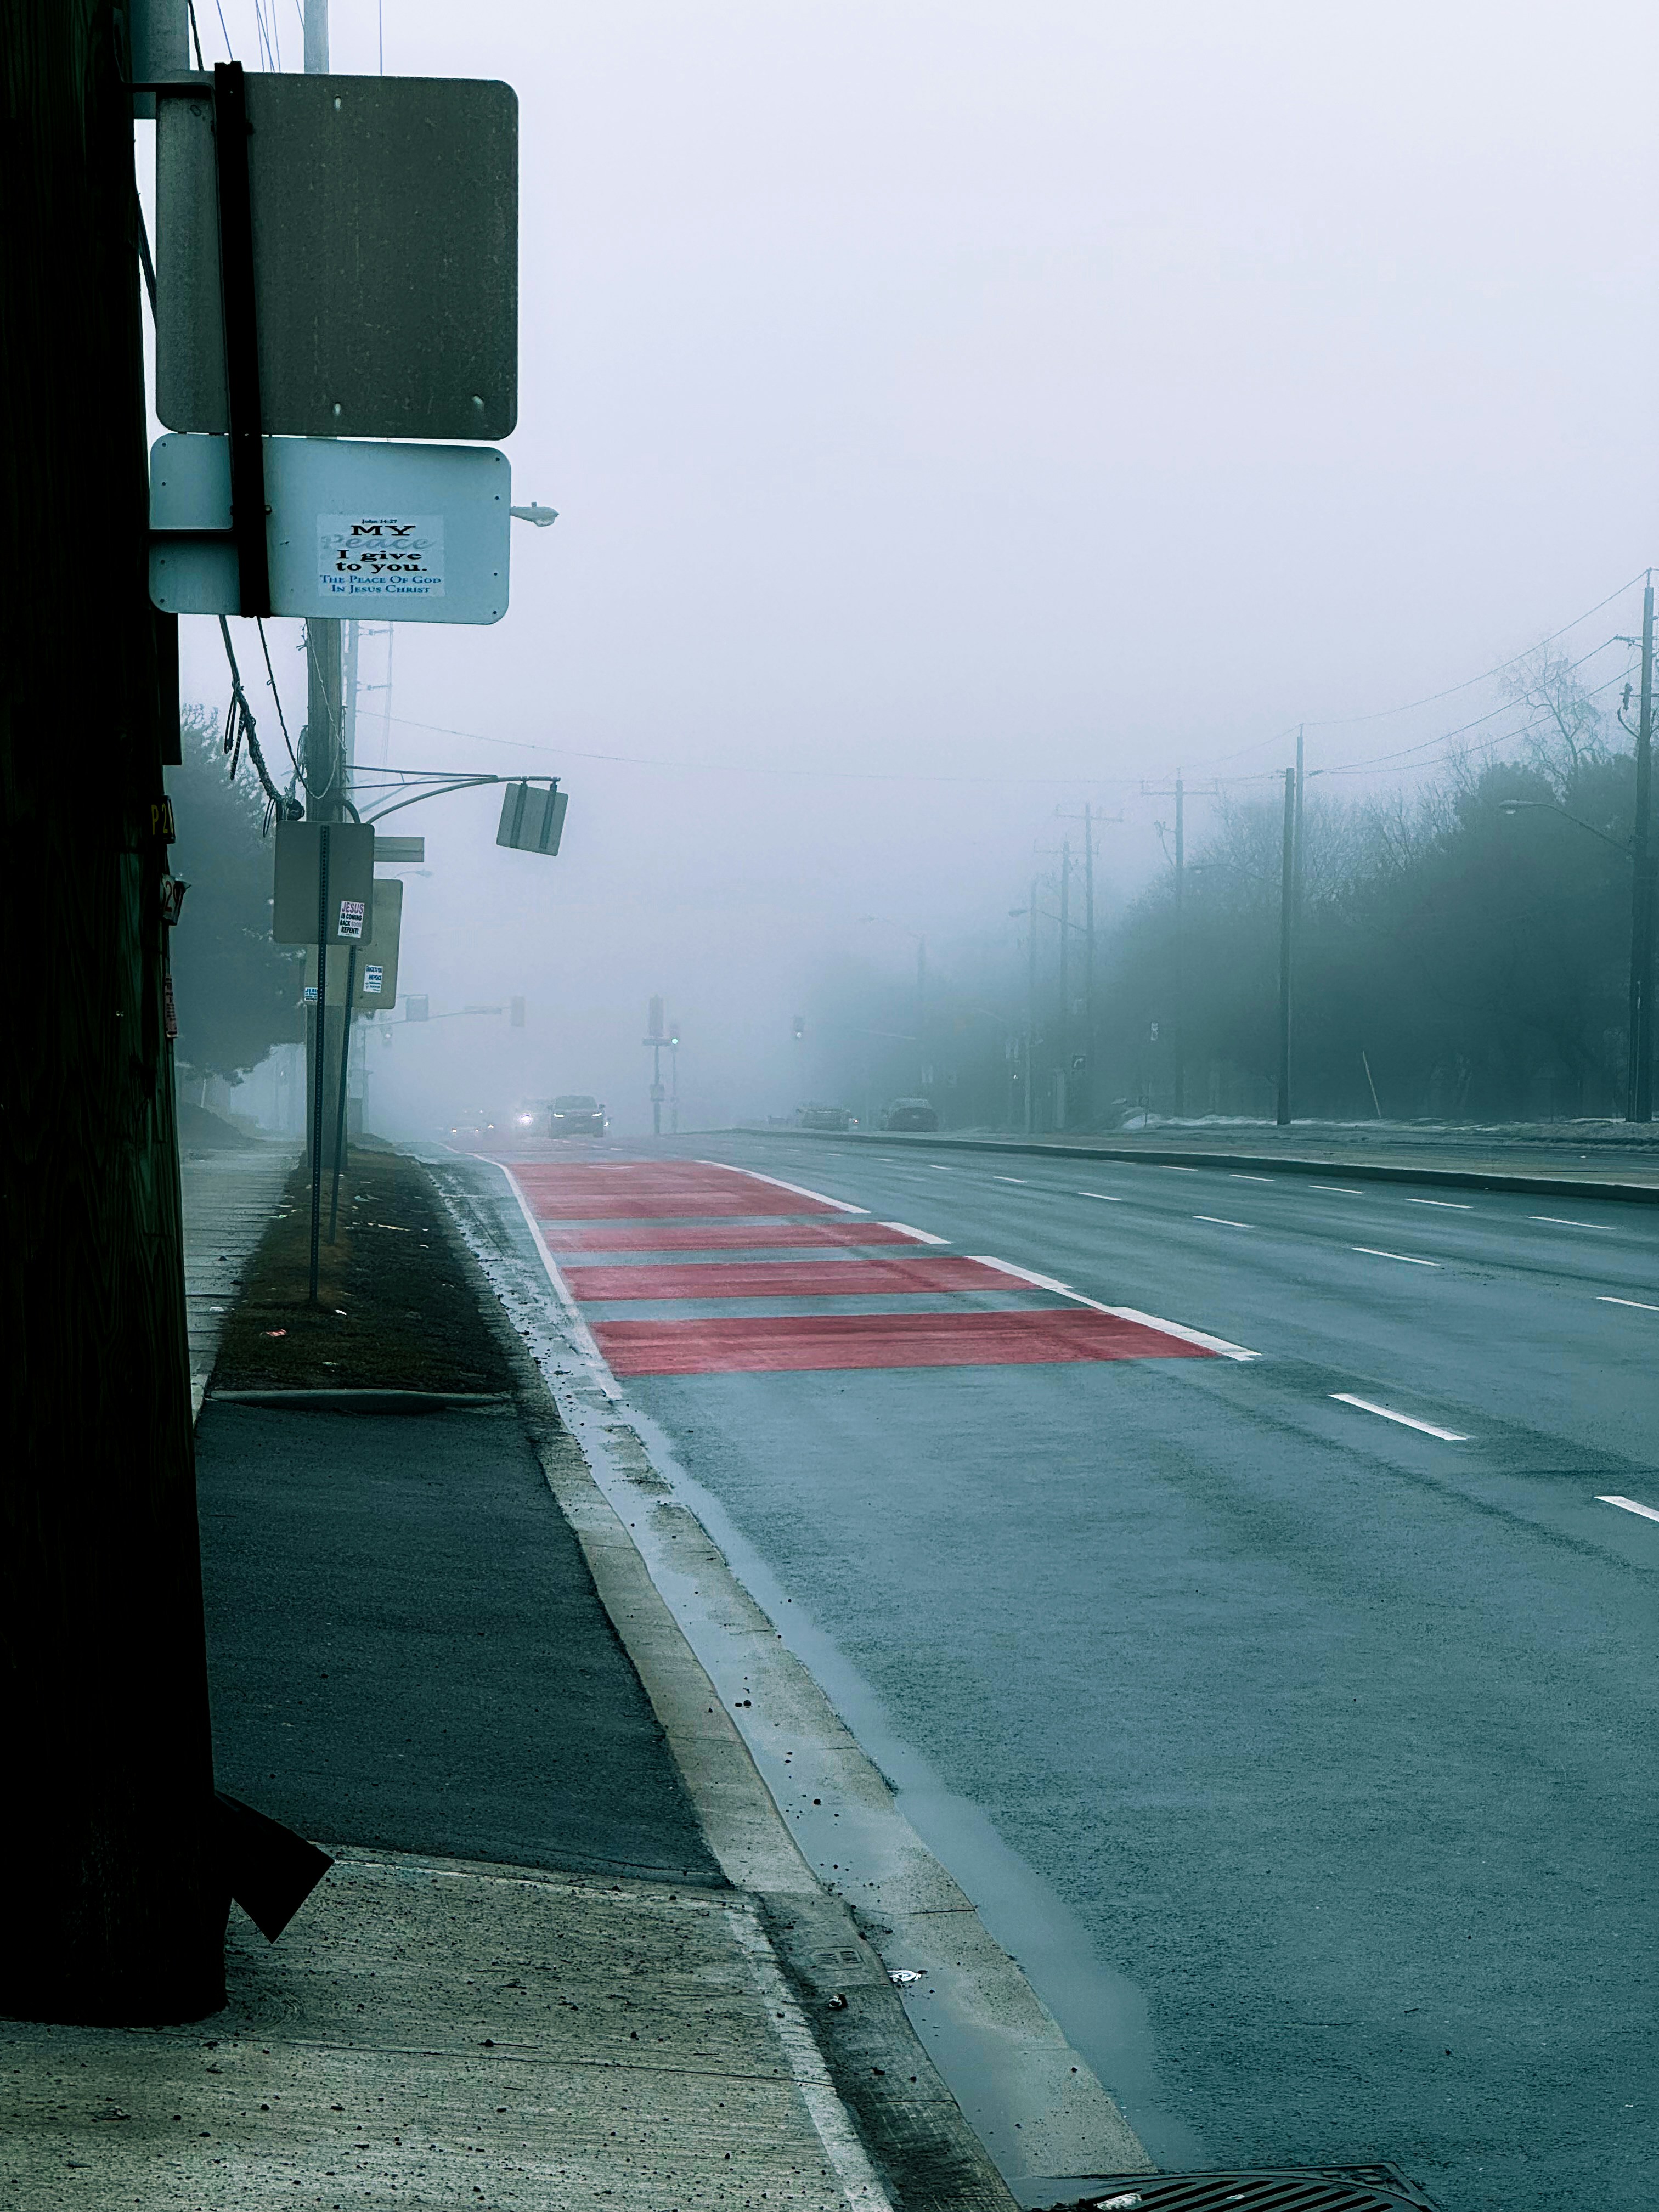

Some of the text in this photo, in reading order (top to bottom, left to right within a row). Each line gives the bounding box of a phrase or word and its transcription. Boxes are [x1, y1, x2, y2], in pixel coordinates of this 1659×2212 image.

[351, 525, 416, 535] MY
[321, 534, 437, 550] Peace
[336, 549, 422, 562] I give
[336, 562, 427, 574] to you.
[341, 902, 364, 914] JESUS
